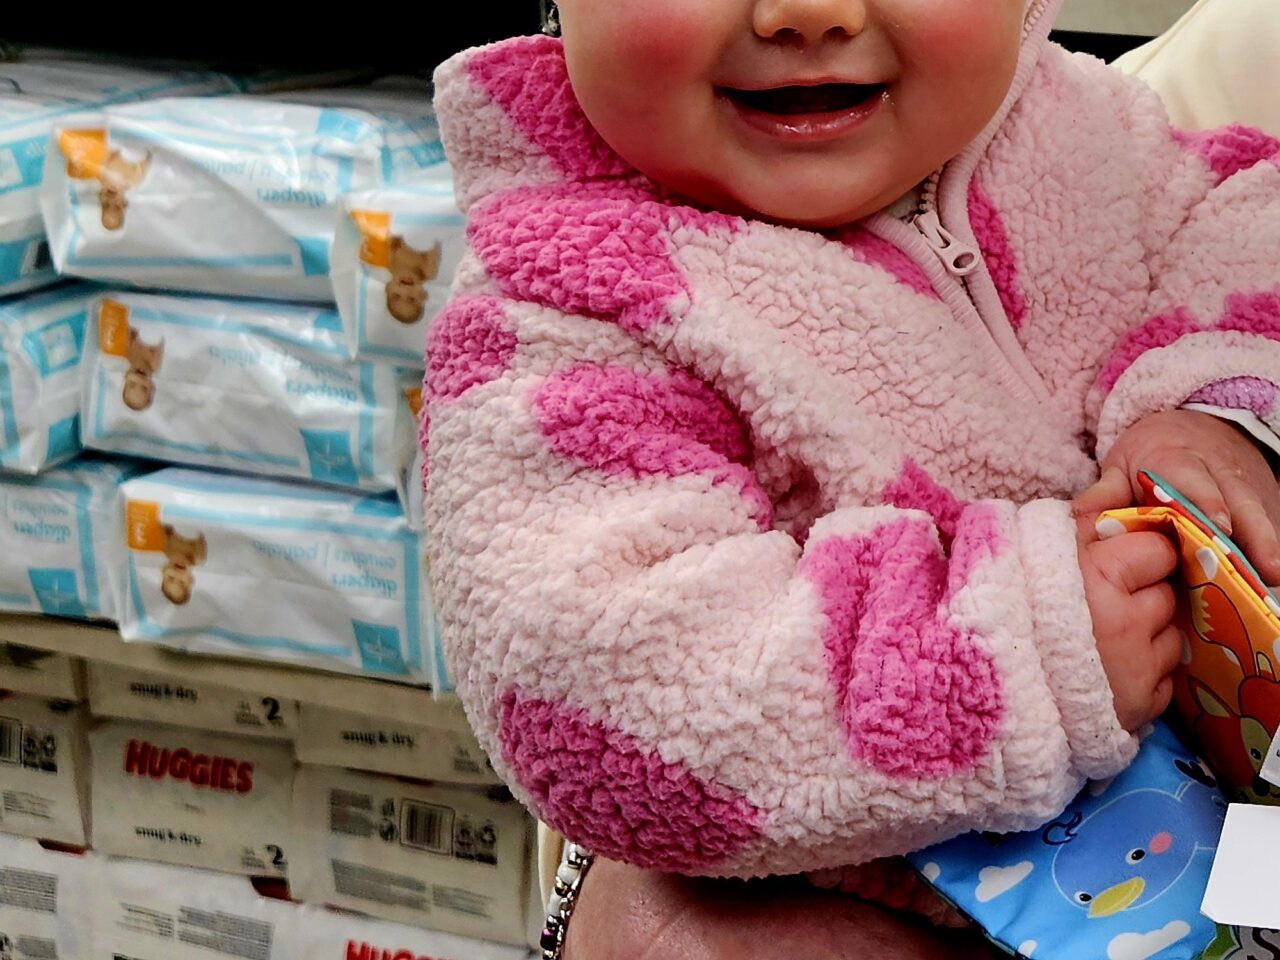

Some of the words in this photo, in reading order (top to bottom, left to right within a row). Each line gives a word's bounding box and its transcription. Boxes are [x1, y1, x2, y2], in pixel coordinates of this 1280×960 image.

[262, 696, 280, 721] 2
[125, 740, 254, 795] HUGGIES
[265, 843, 284, 866] 2
